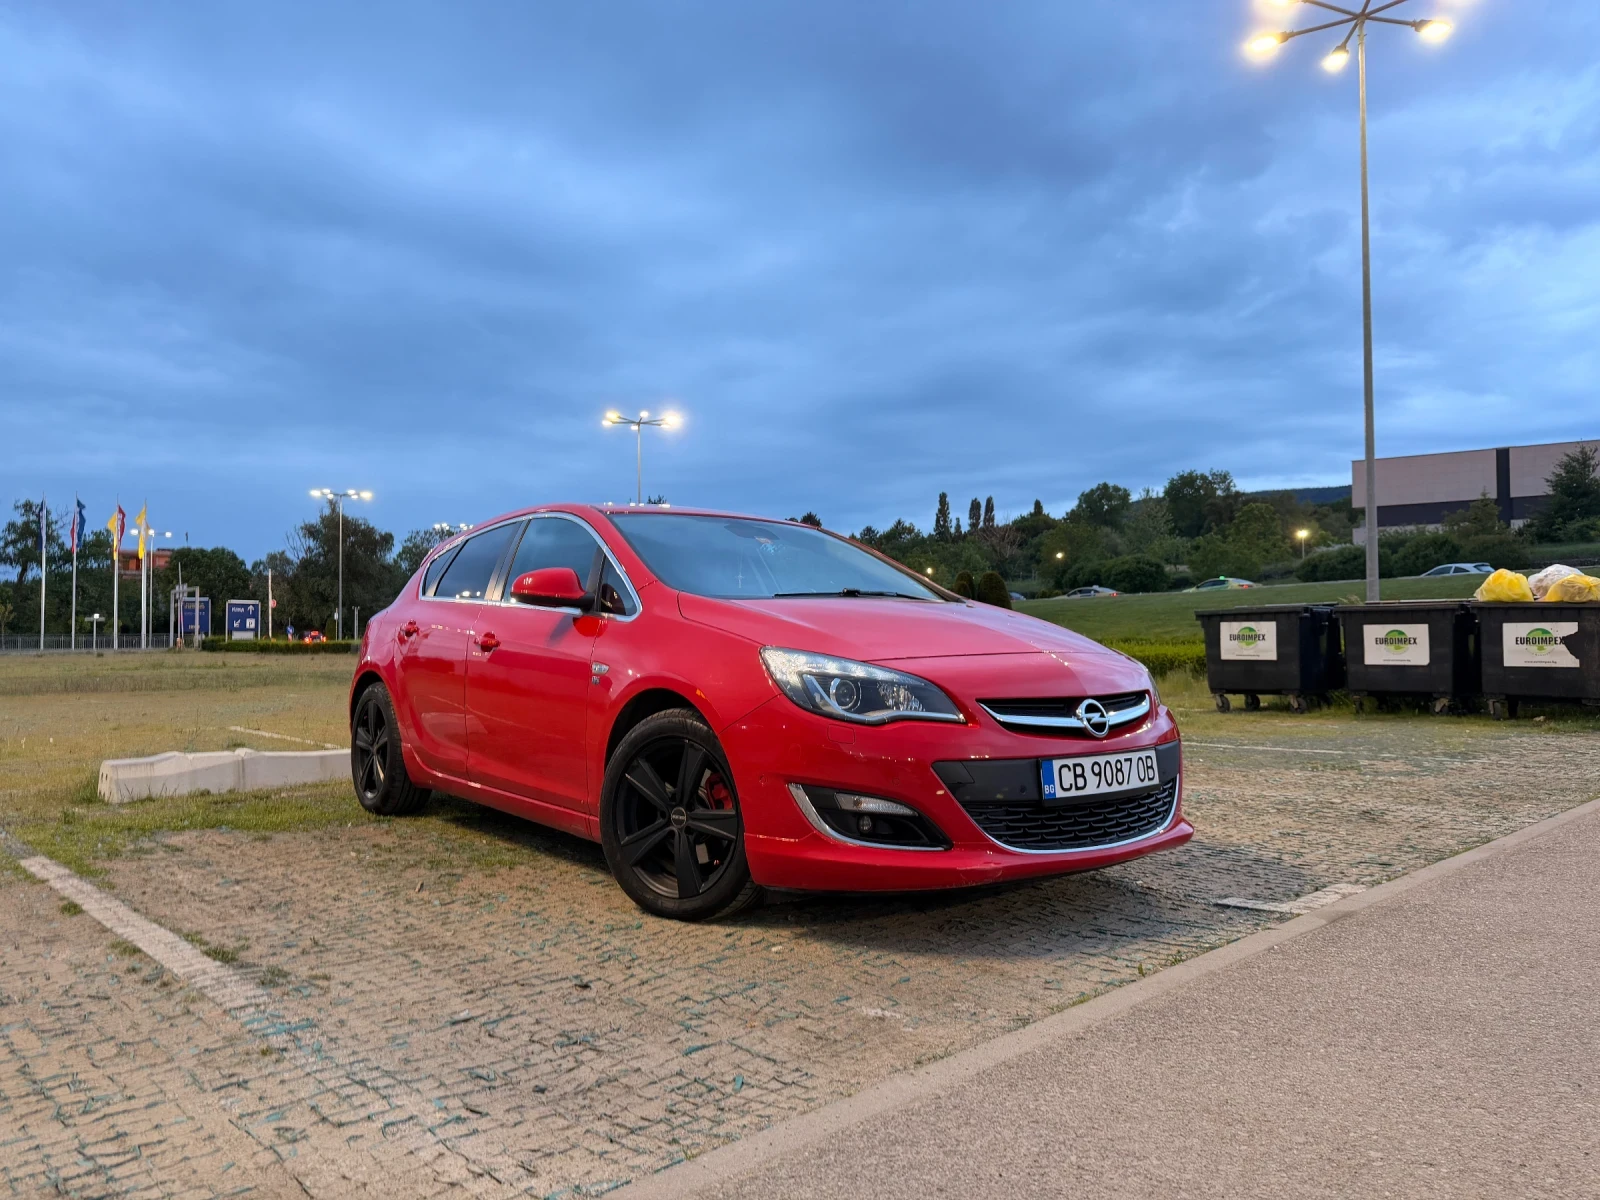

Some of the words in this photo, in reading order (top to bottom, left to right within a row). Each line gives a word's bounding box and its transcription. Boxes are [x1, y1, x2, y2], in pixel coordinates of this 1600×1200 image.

[1375, 637, 1417, 645] EUROIMPEX
[1515, 636, 1565, 645] EUROIMPEX
[1058, 763, 1088, 792] CB
[1091, 757, 1133, 789] 9087
[1044, 784, 1055, 794] BG
